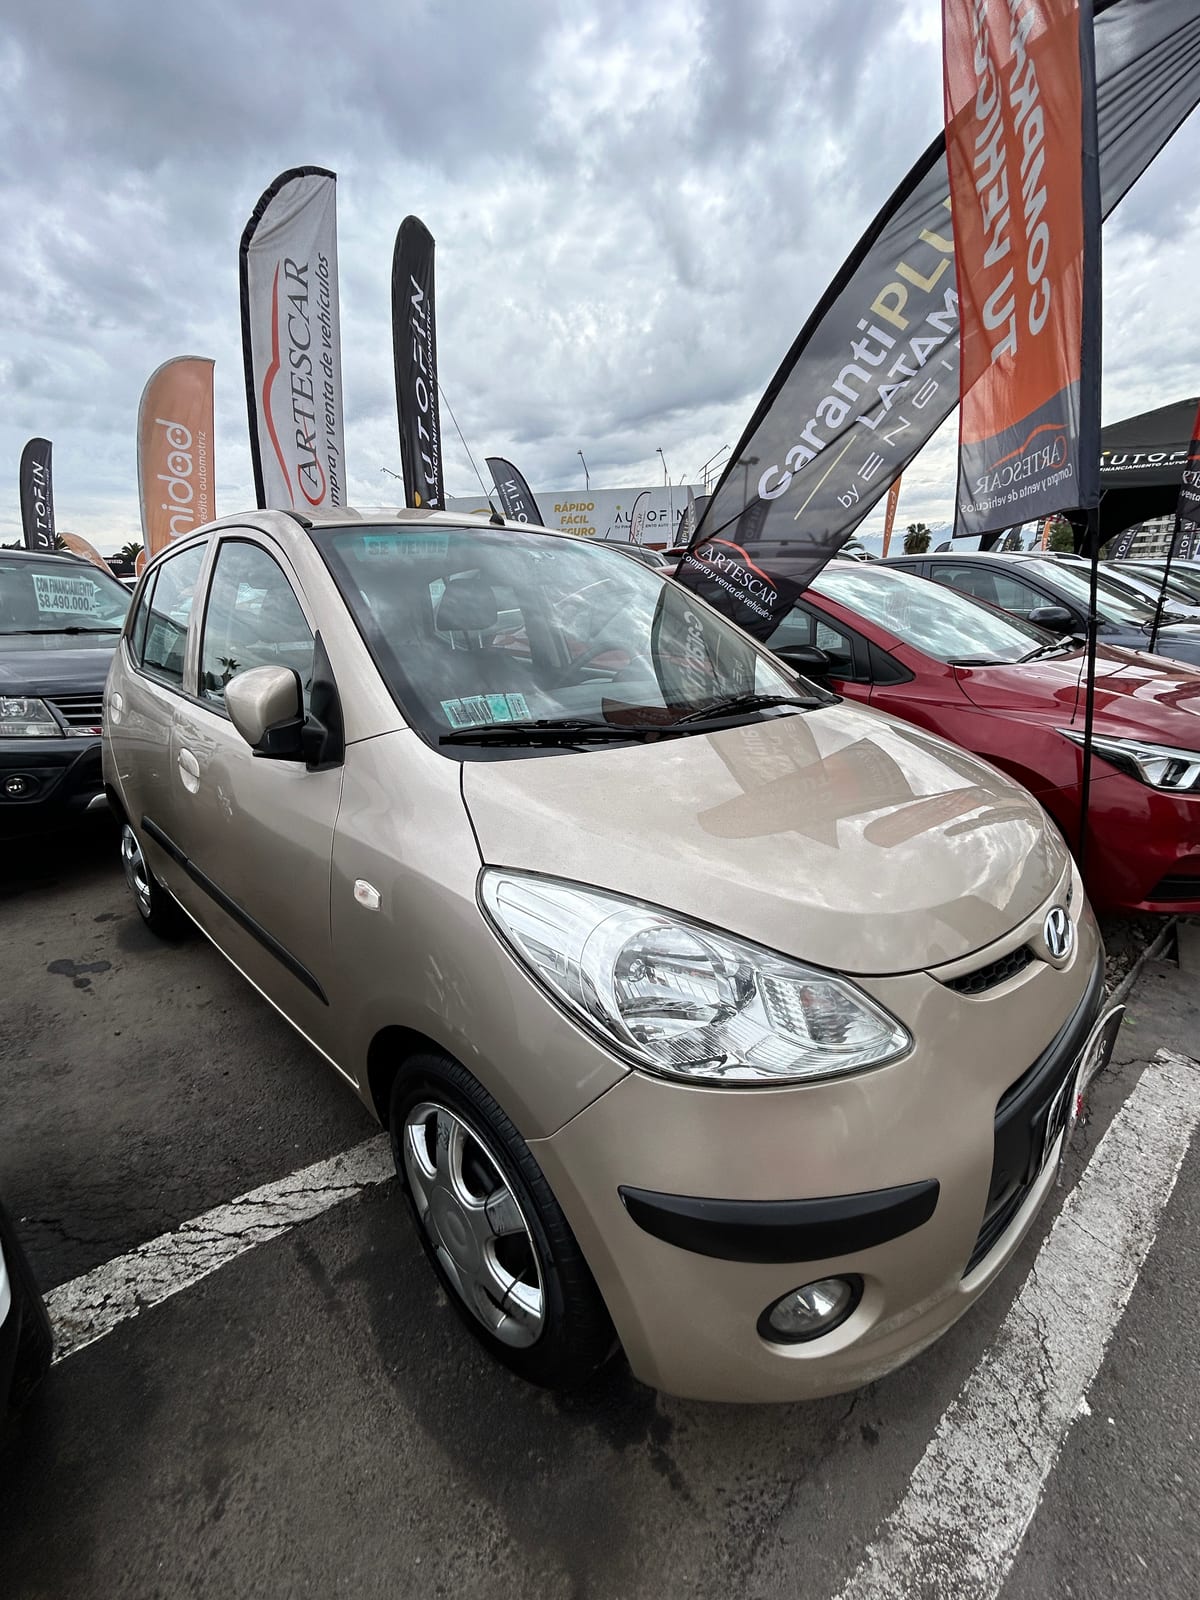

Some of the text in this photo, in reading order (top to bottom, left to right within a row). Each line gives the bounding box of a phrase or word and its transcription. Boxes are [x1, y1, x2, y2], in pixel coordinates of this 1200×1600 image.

[284, 257, 318, 487] ARTESCAR
[319, 351, 334, 376] de
[757, 195, 956, 500] GarantiPLU
[856, 287, 958, 430] LATAM
[321, 386, 336, 438] venta
[837, 339, 961, 509] by ENGI
[155, 418, 194, 544] nidad
[196, 431, 208, 526] rédito automotriz
[328, 442, 341, 456] y
[32, 461, 49, 547] UTOFIN
[330, 458, 340, 508] mpra
[554, 502, 595, 513] RÁPIDO
[561, 513, 589, 525] FÁCIL
[682, 552, 711, 575] Compra
[715, 575, 736, 593] venta
[734, 590, 745, 601] de
[701, 543, 778, 607] ARTESCAR
